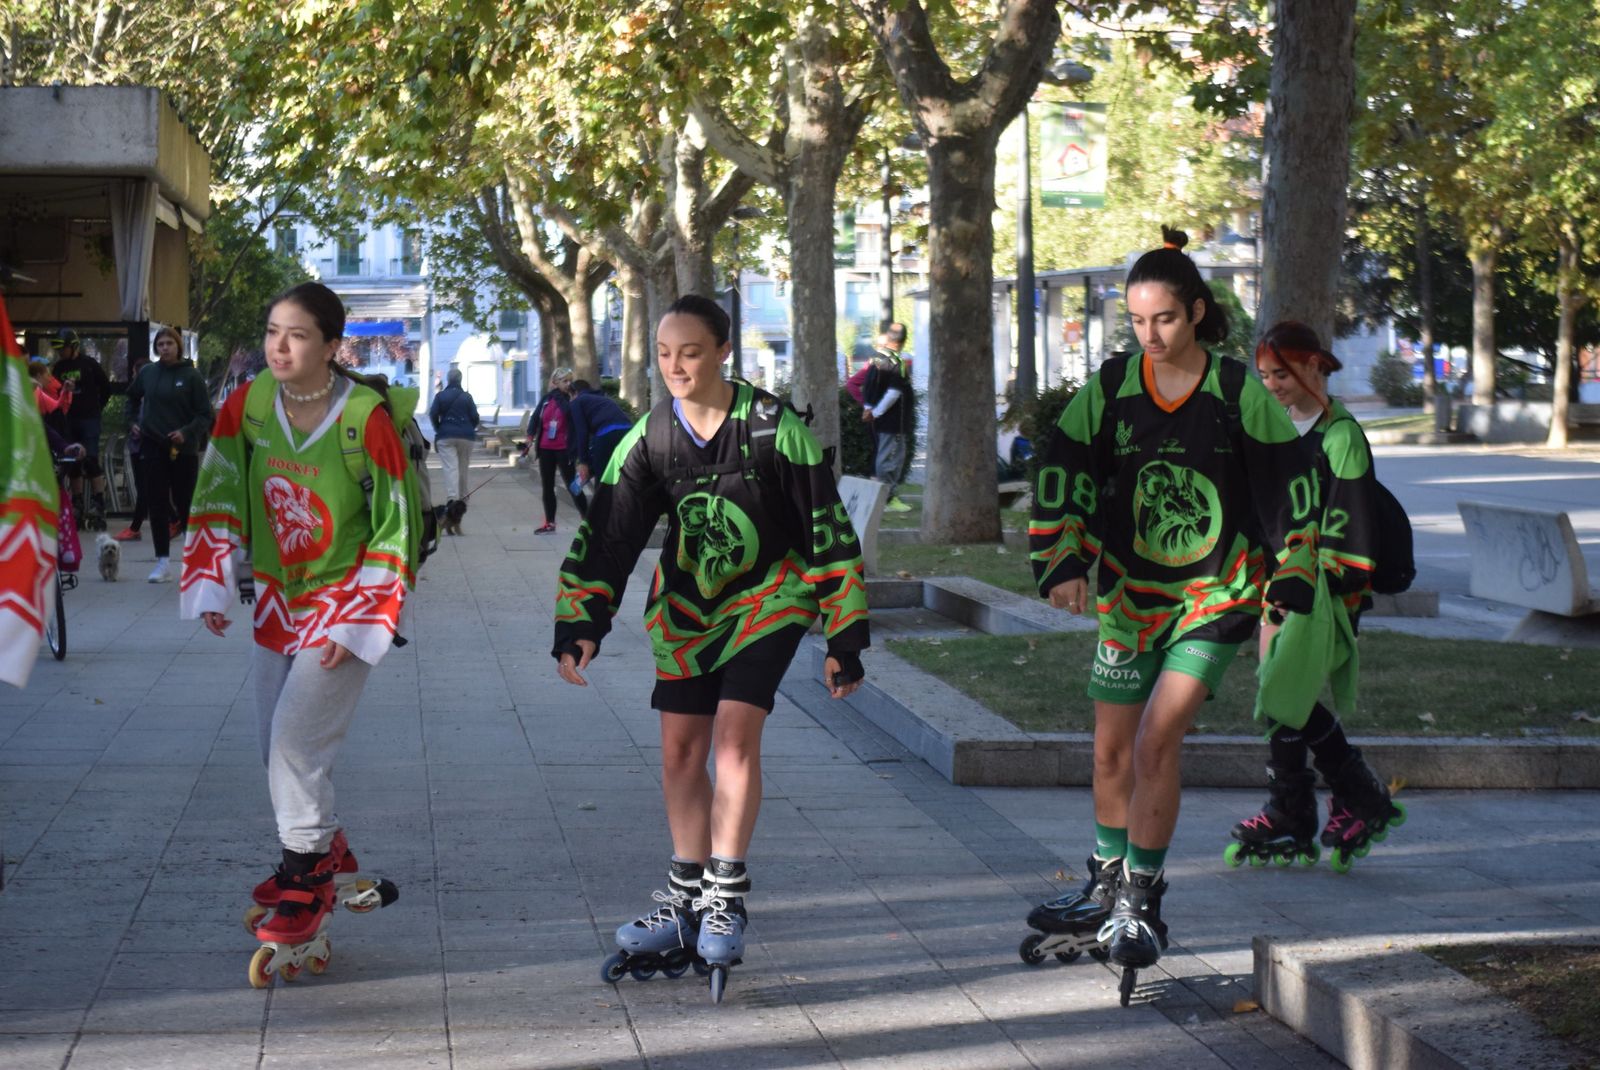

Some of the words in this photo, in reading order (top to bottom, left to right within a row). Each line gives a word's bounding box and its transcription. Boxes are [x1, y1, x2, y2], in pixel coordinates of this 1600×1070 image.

[266, 456, 320, 478] HOCKEY
[1037, 466, 1097, 514] 08
[1094, 660, 1141, 680] OYOTA
